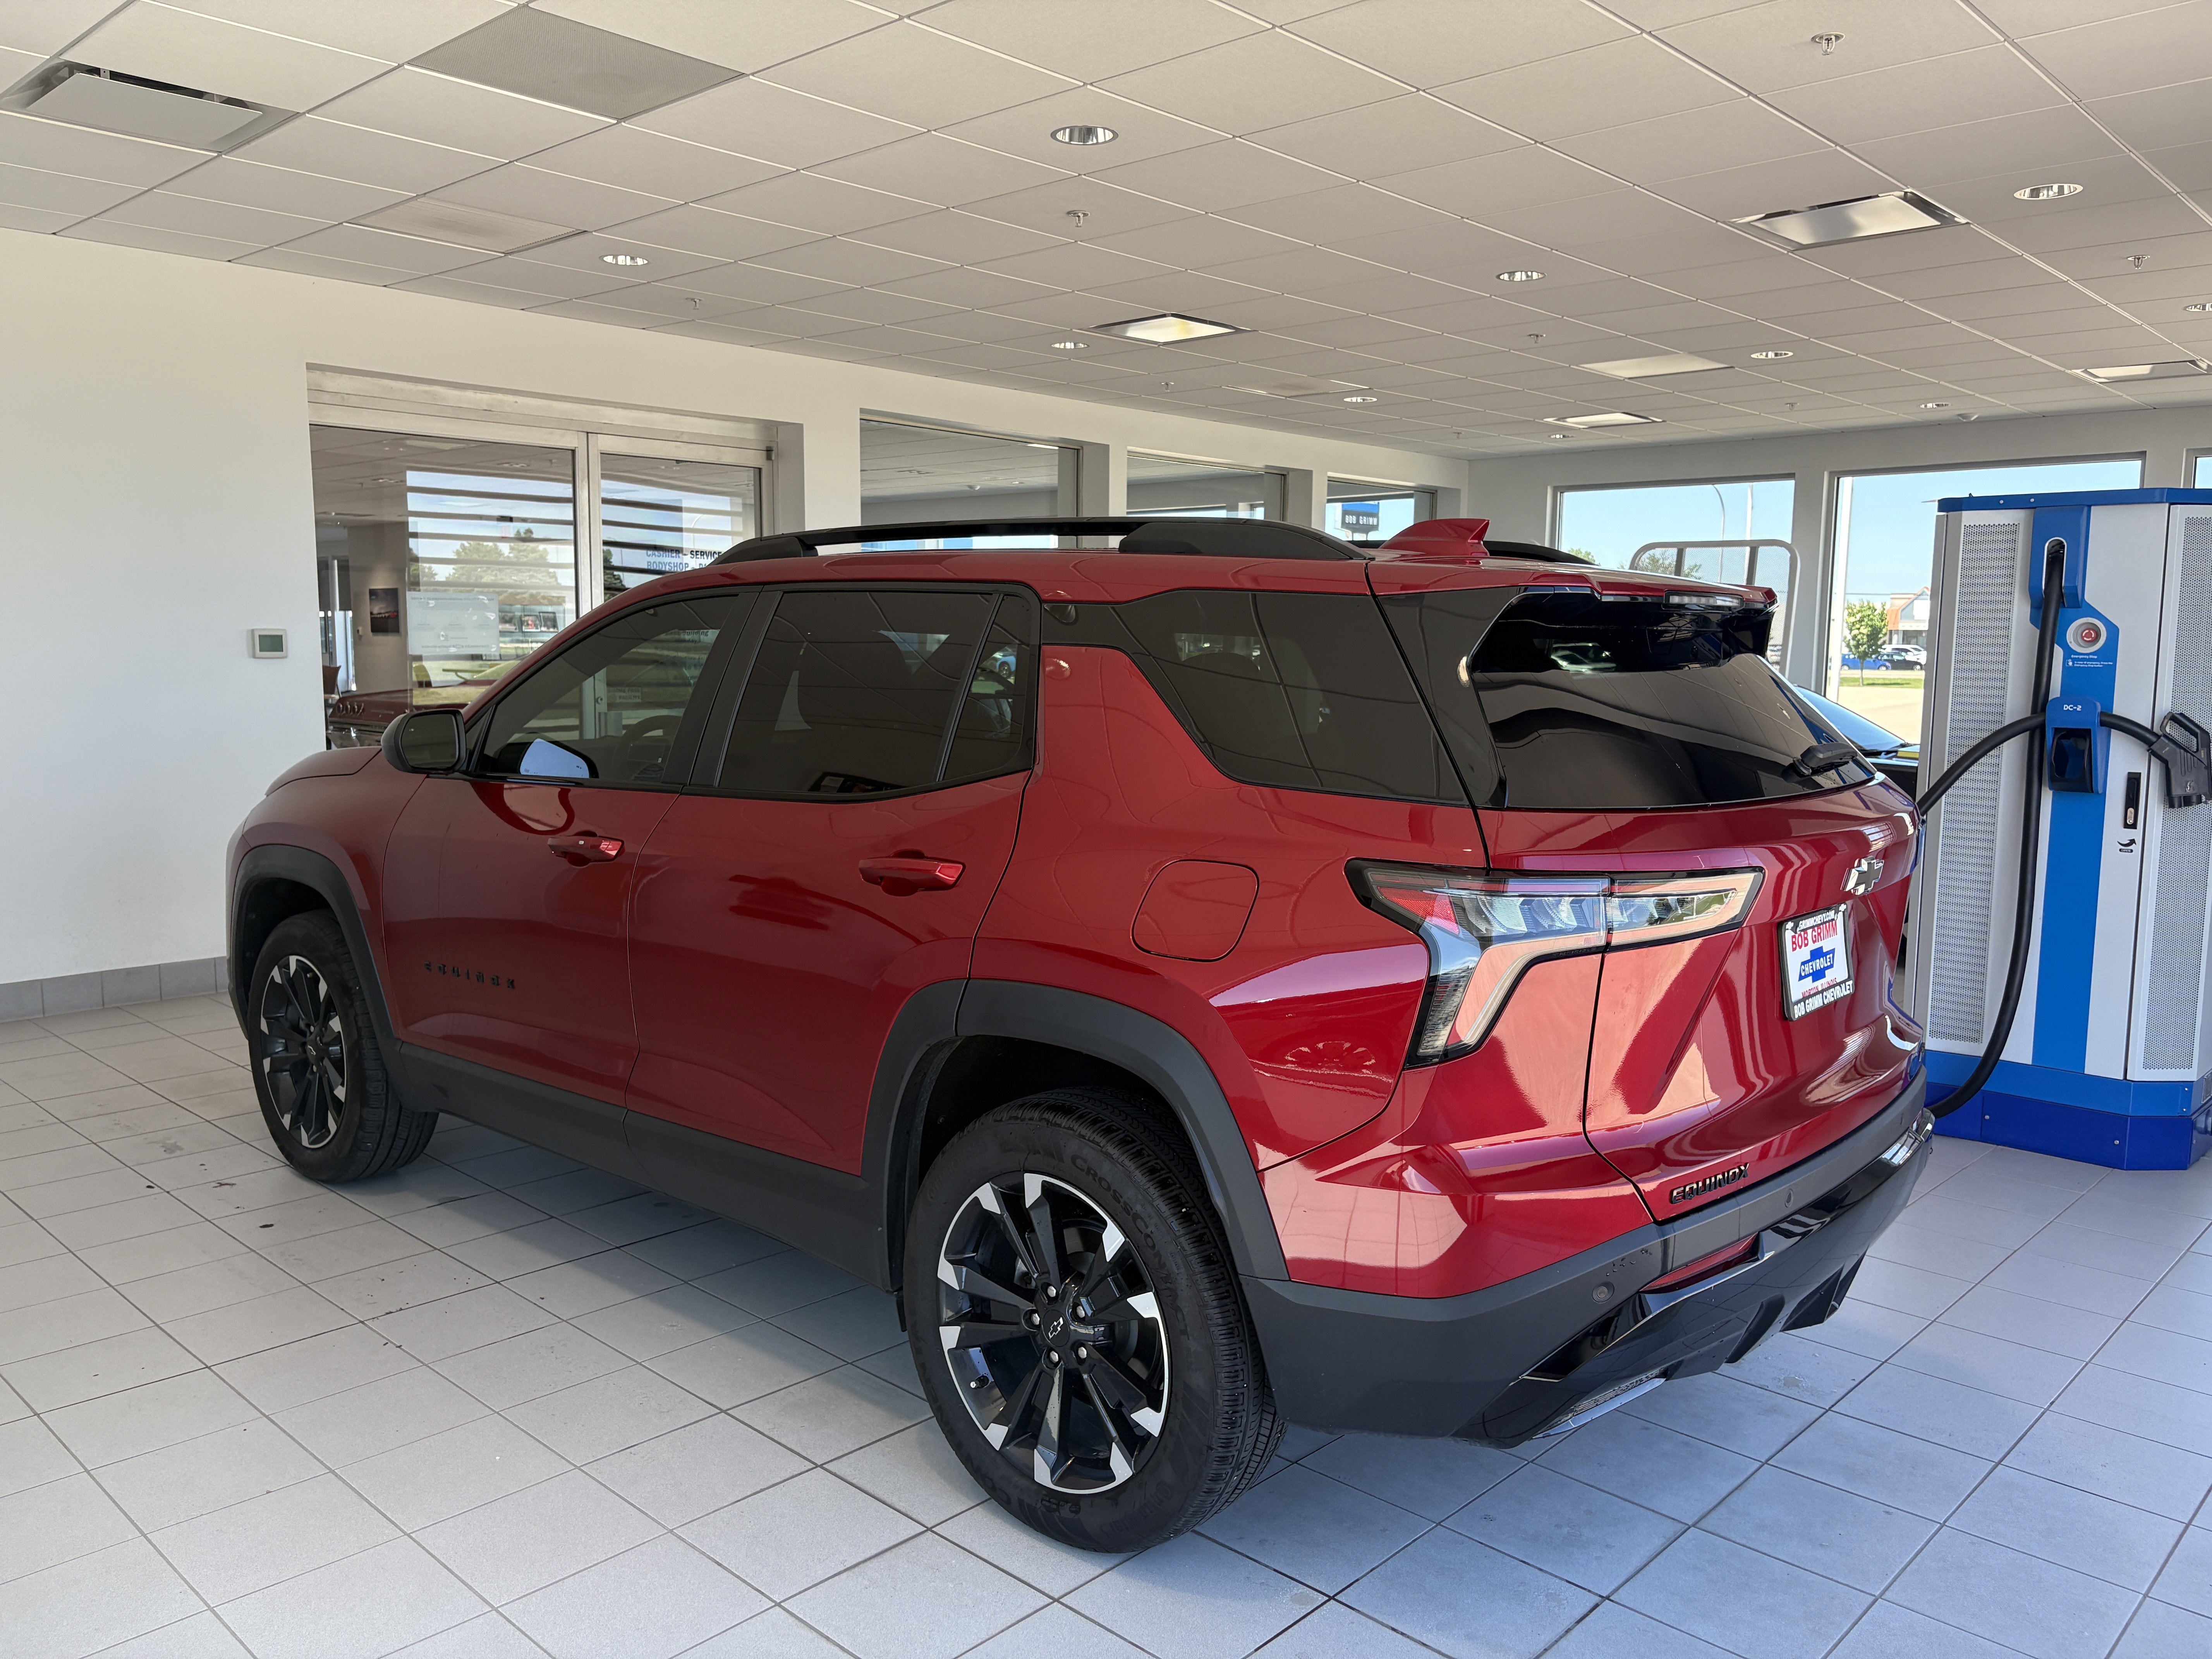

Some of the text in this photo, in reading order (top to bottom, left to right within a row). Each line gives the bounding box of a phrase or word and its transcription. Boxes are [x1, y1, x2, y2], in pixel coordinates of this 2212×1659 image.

[646, 549, 680, 558] CASHIER
[647, 561, 689, 571] BODYSHOP
[1791, 920, 1838, 952] BOB GRIMM
[1801, 953, 1833, 976] CHEVROLET
[1794, 980, 1853, 1018] BOB GRIMM CHEVROLET
[1669, 1162, 1749, 1204] EQUINOX
